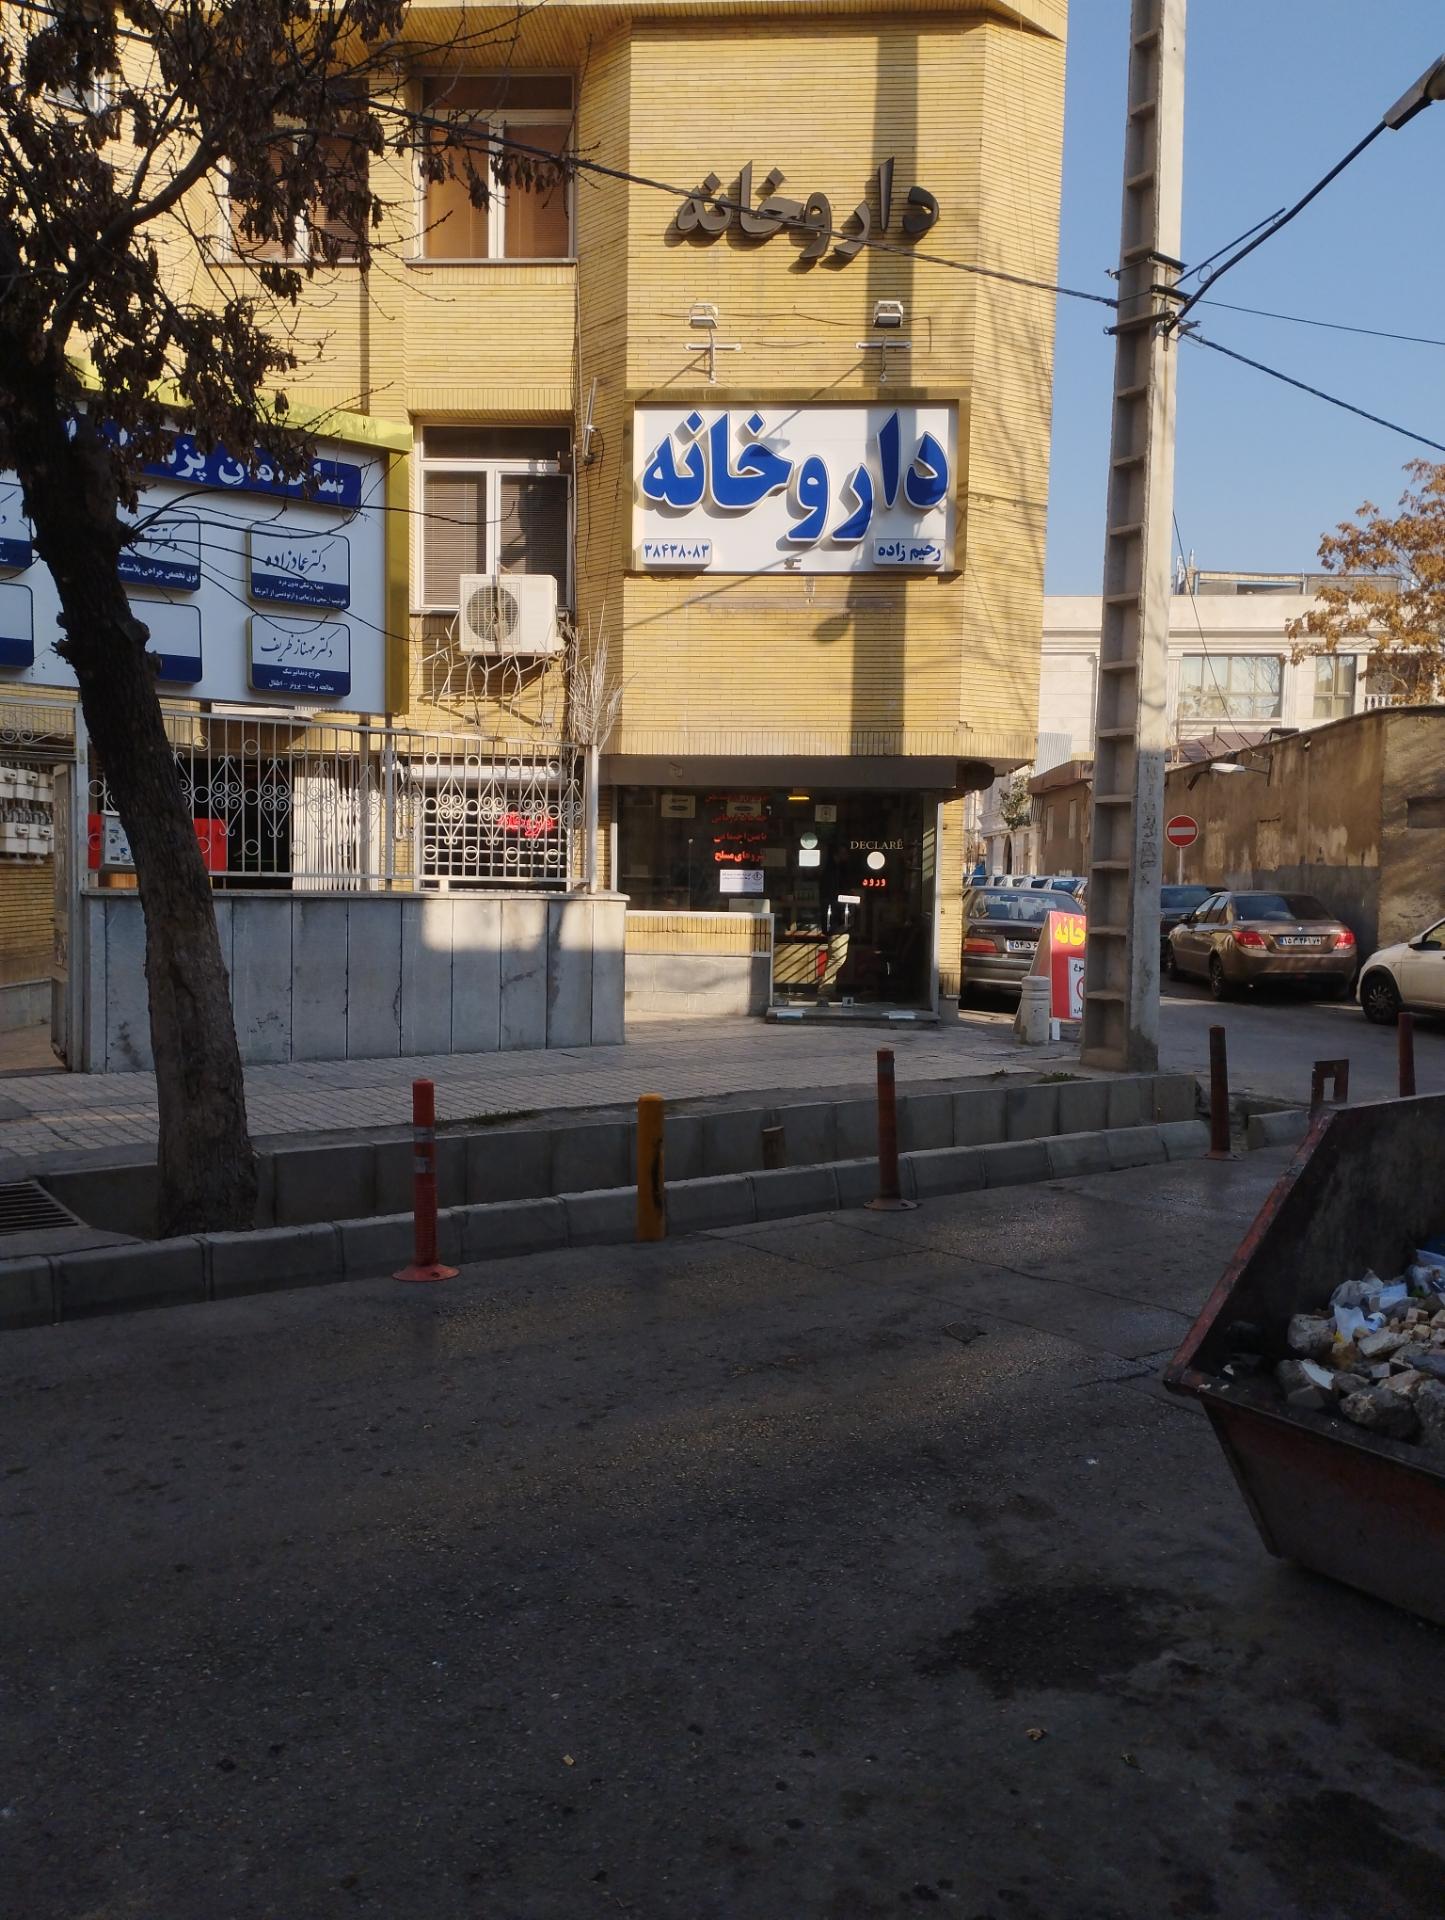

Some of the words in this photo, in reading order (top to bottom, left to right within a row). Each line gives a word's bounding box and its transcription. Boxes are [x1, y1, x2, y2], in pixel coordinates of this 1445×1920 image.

[675, 156, 940, 260] داروخانه
[641, 409, 950, 543] داروخانه
[303, 540, 336, 575] دکتر
[644, 543, 709, 560] ۳۸۴۳۸۰۸۳
[878, 542, 907, 561] زاده
[909, 543, 941, 562] رحیم
[260, 634, 294, 662] ظریف
[294, 638, 315, 656] مهناز
[312, 628, 341, 660] دکتر
[850, 838, 904, 850] DECLARÉ
[862, 878, 886, 887] ورود
